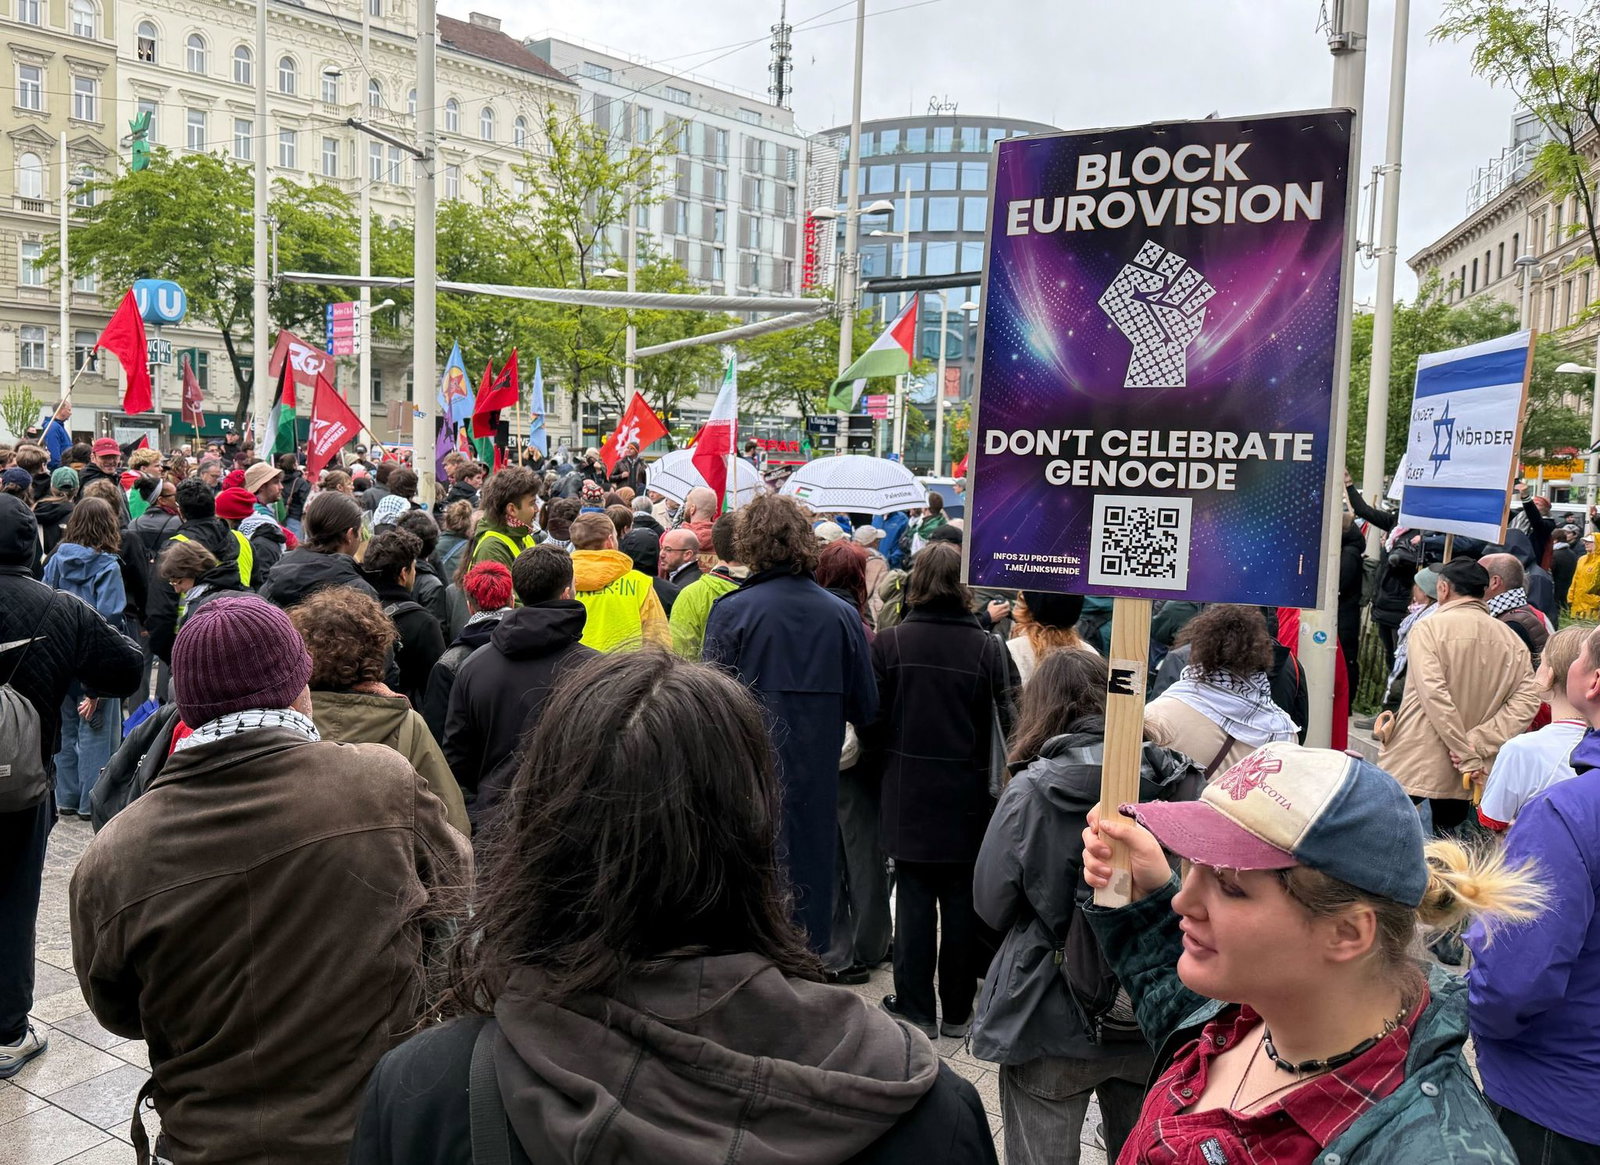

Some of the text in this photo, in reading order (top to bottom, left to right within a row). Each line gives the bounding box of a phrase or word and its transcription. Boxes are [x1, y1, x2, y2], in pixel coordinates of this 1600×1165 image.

[1076, 143, 1252, 191] BLOCK
[1006, 181, 1325, 236] EUROVISION
[158, 288, 181, 318] U
[160, 340, 171, 353] WC
[985, 430, 1314, 462] DON'T CELEBRATE
[1456, 426, 1513, 446] MÖRDER
[1044, 460, 1238, 491] GENOCIDE
[993, 552, 1081, 564] INFOS ZU PROTESTEN:
[1004, 563, 1080, 575] T.ME/LINKSWENDE
[1257, 782, 1292, 810] SCOTIA
